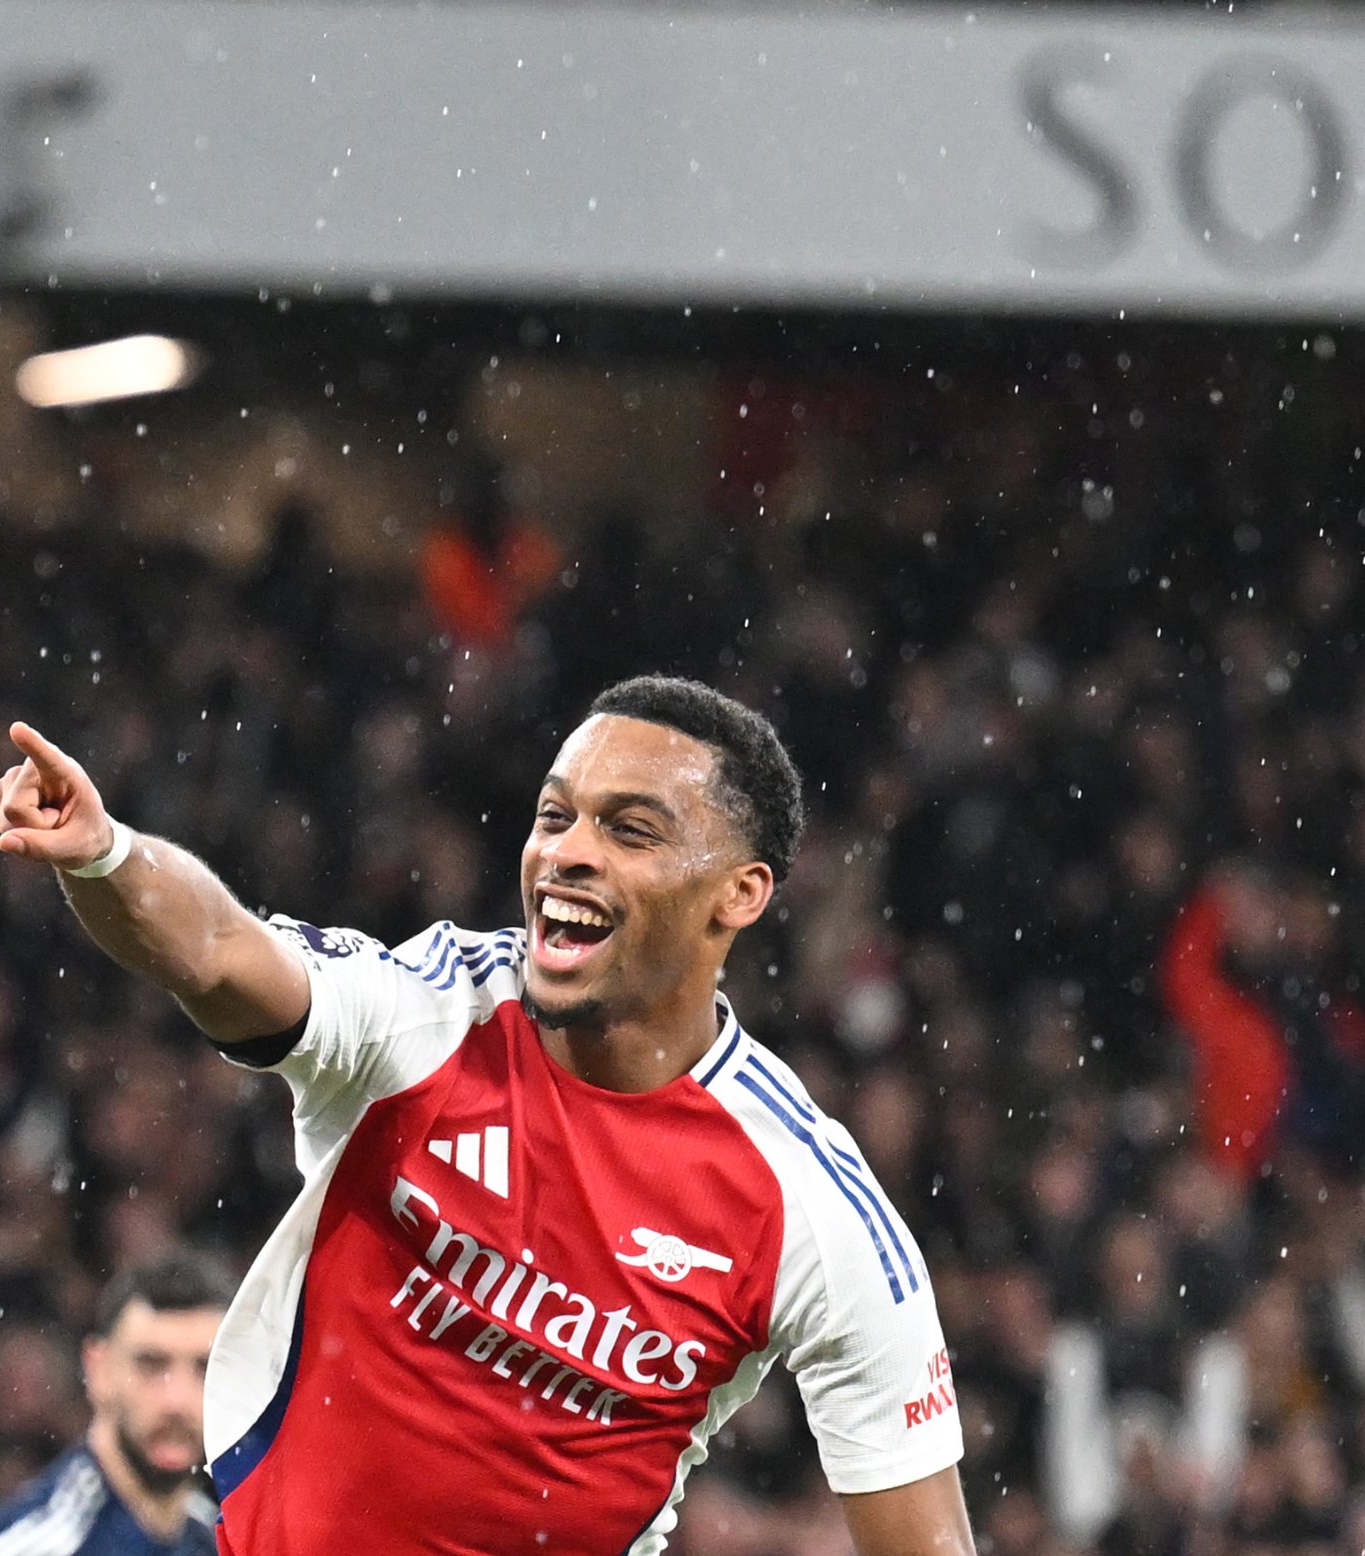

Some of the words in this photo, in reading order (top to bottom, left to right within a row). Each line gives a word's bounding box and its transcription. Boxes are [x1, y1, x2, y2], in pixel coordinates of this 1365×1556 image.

[389, 1265, 472, 1341] FLY
[464, 1322, 631, 1427] BETTER
[390, 1176, 707, 1391] Emirates
